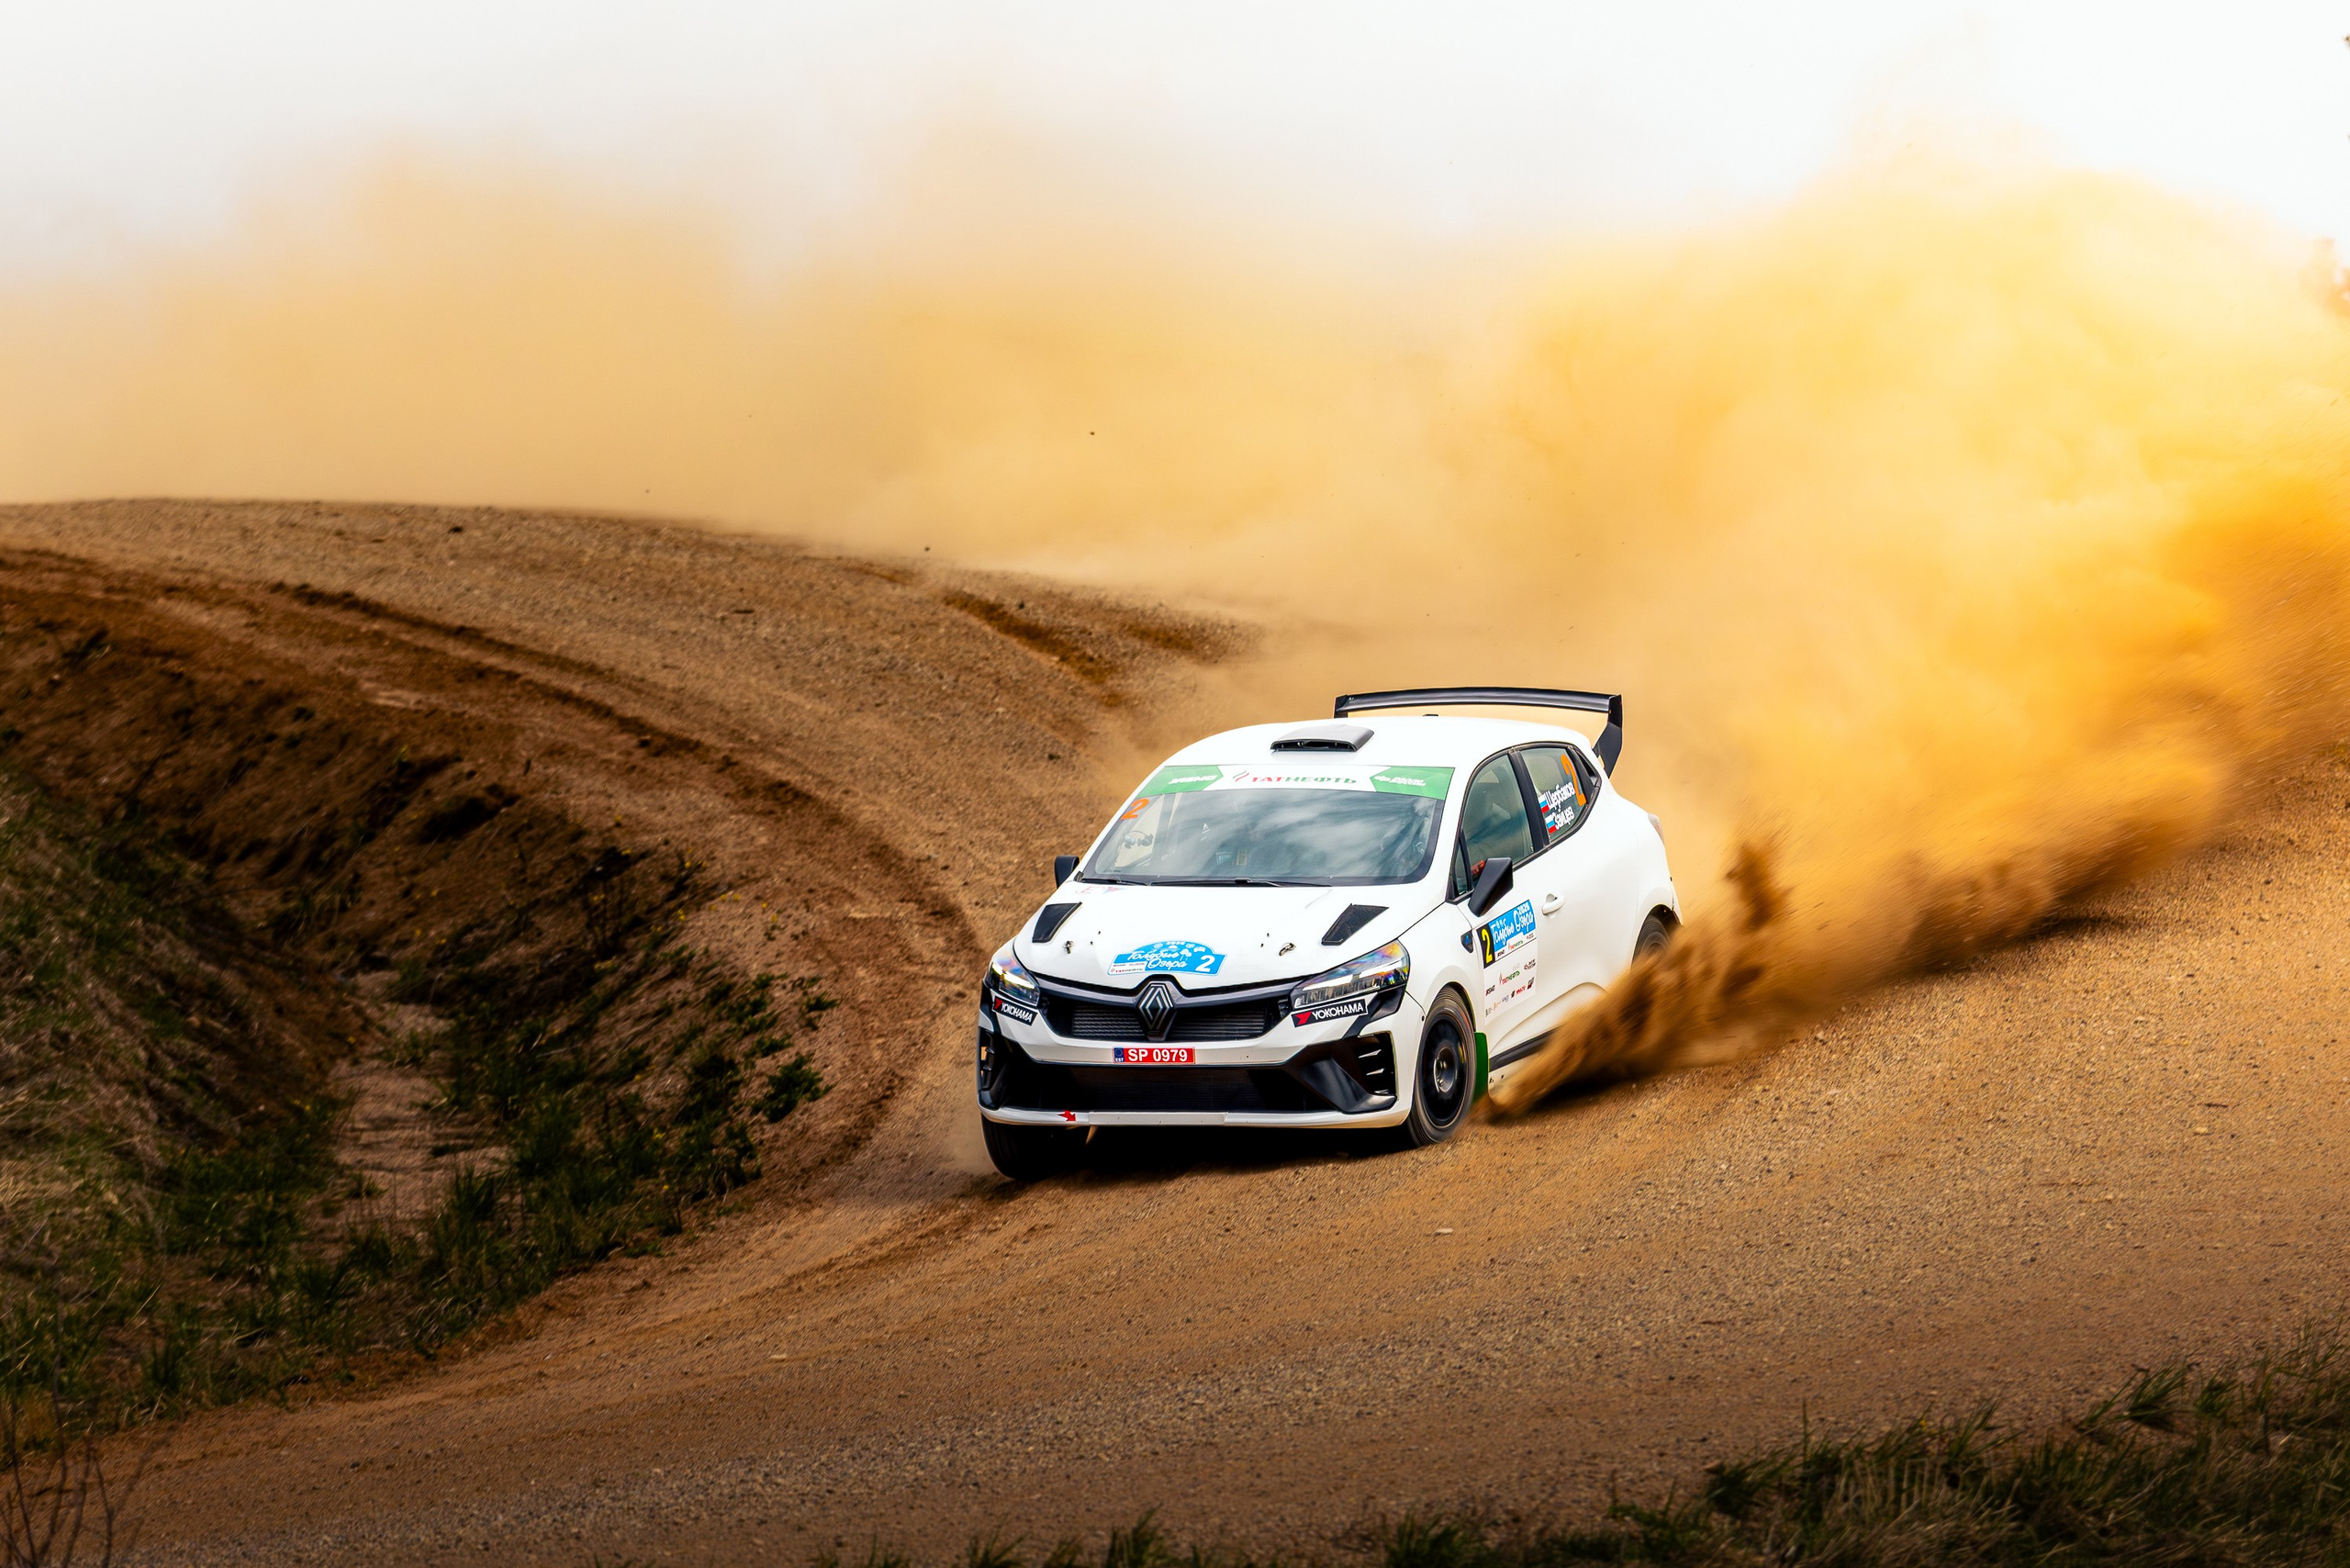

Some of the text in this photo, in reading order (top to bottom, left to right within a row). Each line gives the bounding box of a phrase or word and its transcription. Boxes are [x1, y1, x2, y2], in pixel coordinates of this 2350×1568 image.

[1561, 754, 1586, 807] 2
[1121, 798, 1149, 820] 2
[1482, 928, 1493, 964] 2
[1147, 958, 1188, 970] Озера
[1195, 955, 1214, 972] 2
[1001, 1002, 1033, 1023] YOKOHAMA
[1312, 1002, 1363, 1020] YOKOHAMA
[1127, 1048, 1188, 1062] SP 0979
